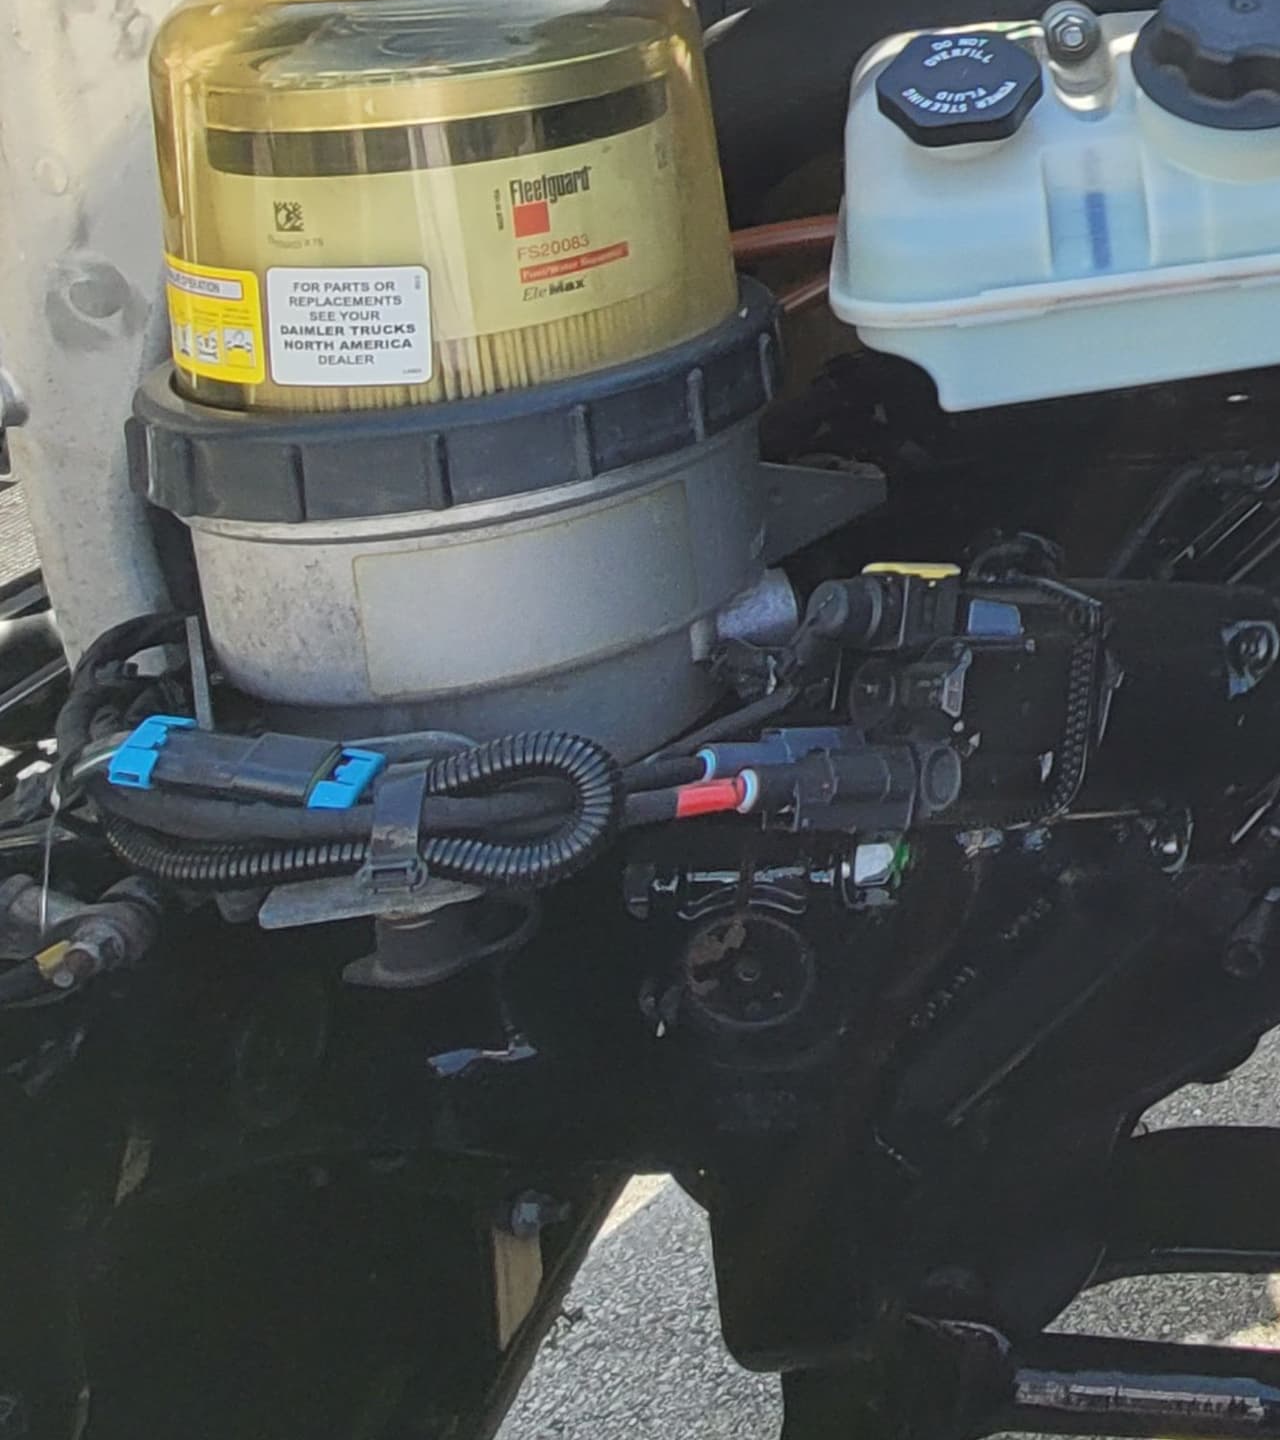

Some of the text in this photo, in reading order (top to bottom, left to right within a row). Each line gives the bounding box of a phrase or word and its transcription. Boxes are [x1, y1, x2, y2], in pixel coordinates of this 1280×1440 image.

[931, 38, 989, 51] DO NOT
[923, 47, 995, 67] OVERFILL
[901, 80, 1018, 114] POWER STEERING
[936, 87, 988, 103] FLUID
[509, 165, 591, 206] Fleetguard
[517, 233, 591, 261] FS20083
[293, 281, 395, 292] FOR PARTS OR
[289, 295, 402, 307] REPLACEMENTS
[310, 310, 380, 322] SEE YOUR
[280, 324, 416, 336] DAIMLER TRUCKS
[284, 338, 413, 351] NORTH AMERICA
[318, 354, 375, 365] DEALER
